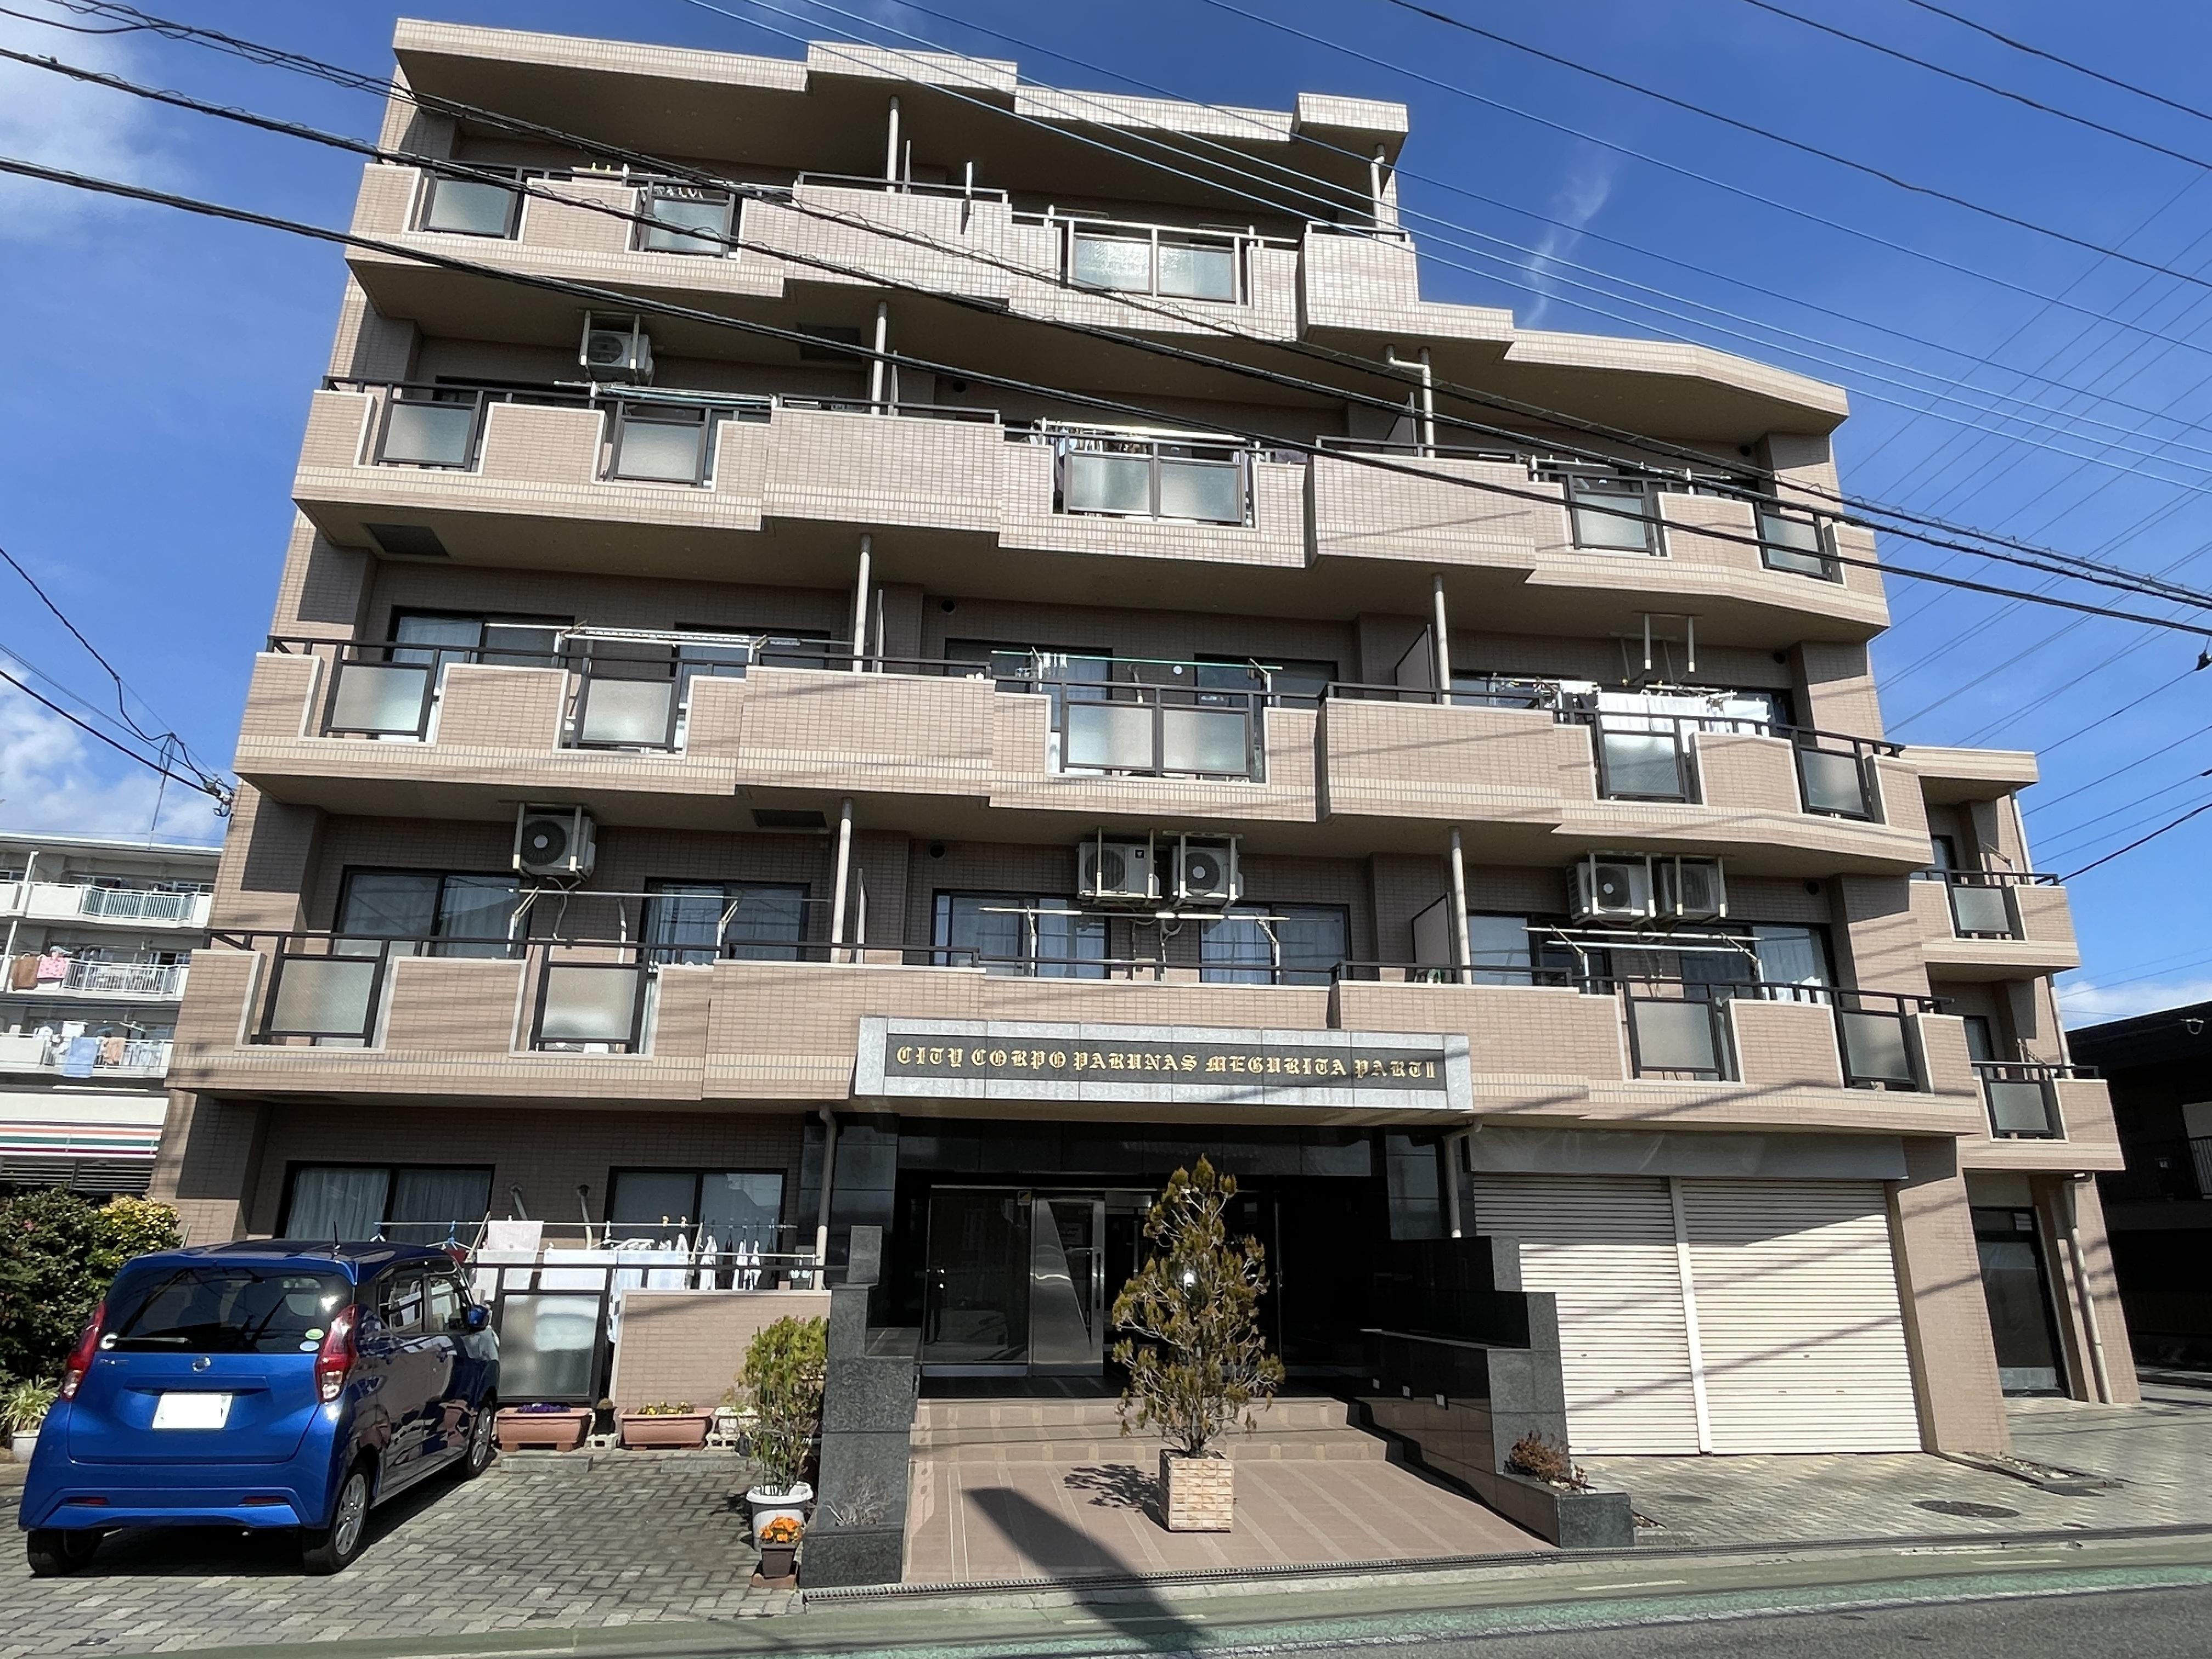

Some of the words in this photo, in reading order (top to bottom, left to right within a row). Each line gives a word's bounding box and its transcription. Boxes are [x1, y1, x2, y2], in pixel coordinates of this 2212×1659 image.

[896, 1046, 963, 1068] CITY
[971, 1048, 1066, 1070] CORPO
[1205, 1055, 1347, 1075] MEGURITA
